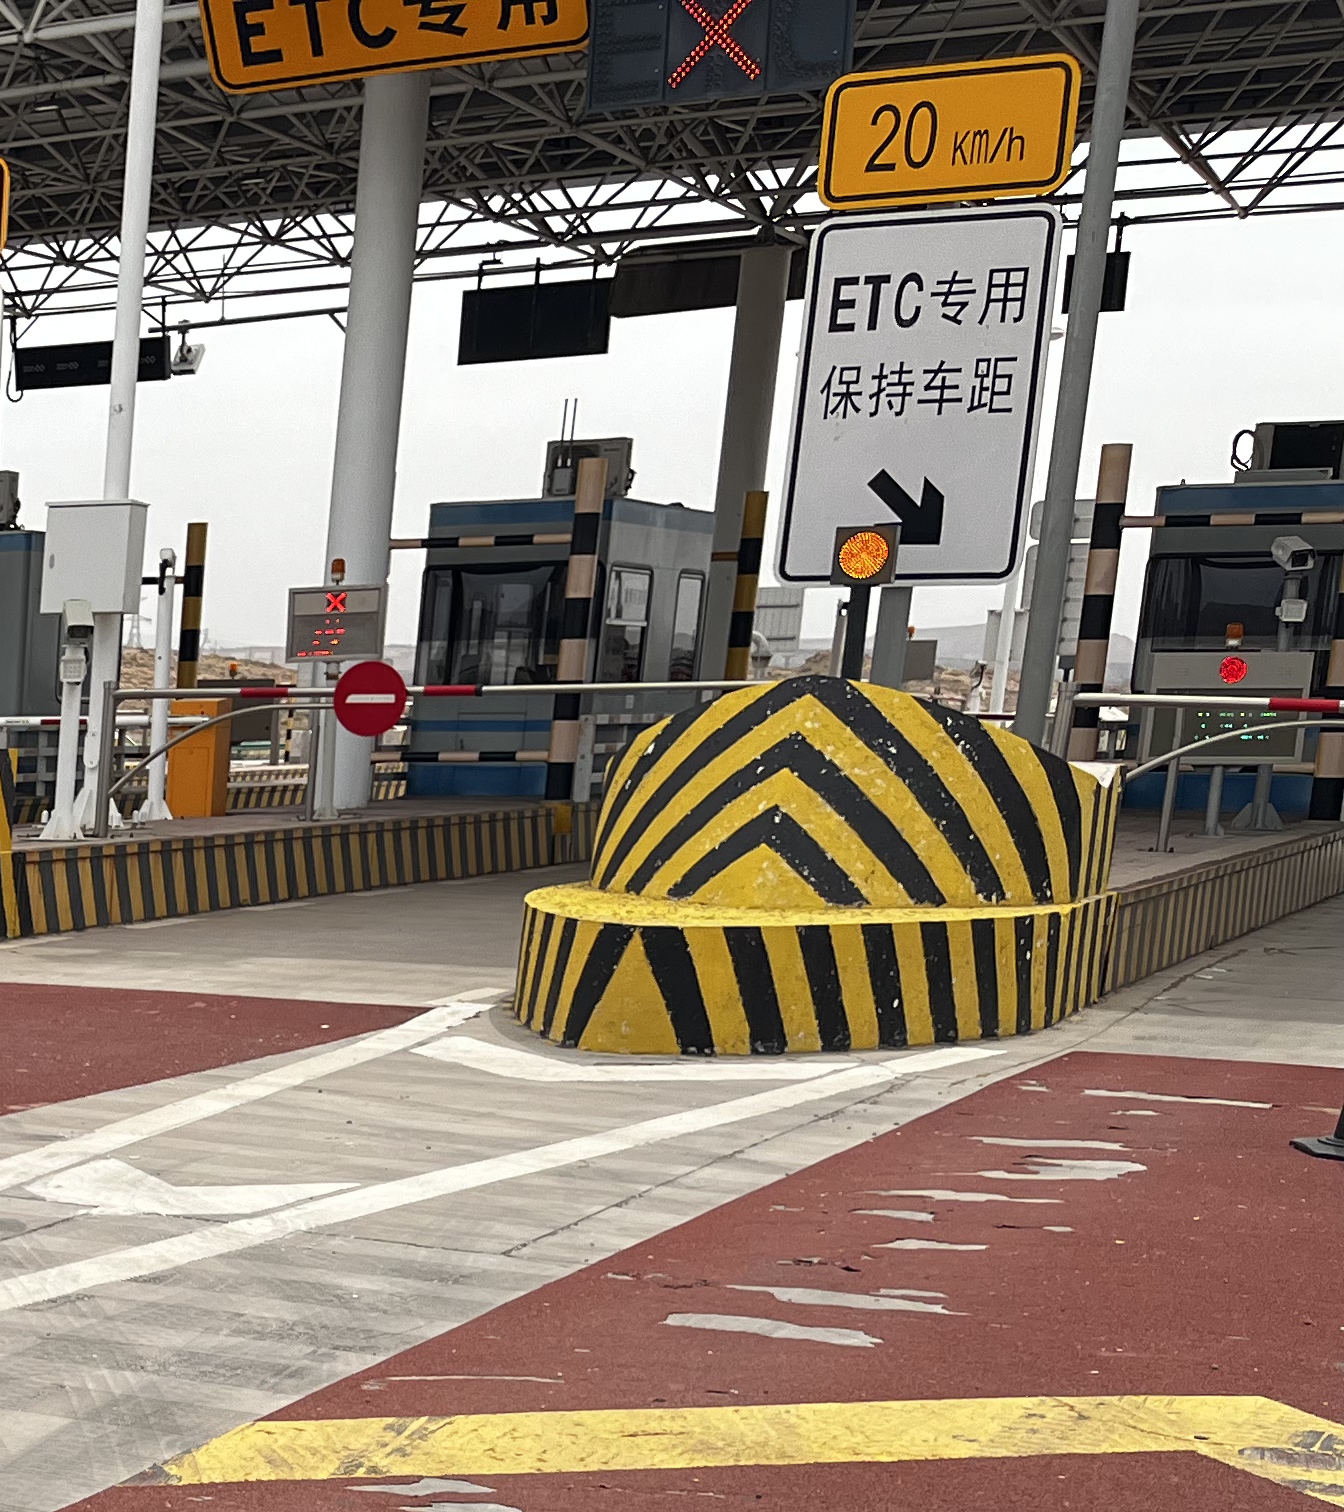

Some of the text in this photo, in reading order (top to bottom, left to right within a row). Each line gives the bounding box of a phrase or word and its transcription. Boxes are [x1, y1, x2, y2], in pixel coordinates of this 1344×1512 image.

[864, 100, 938, 174] 20
[828, 266, 1030, 334] ETC专用
[820, 356, 1018, 420] 保持车距
